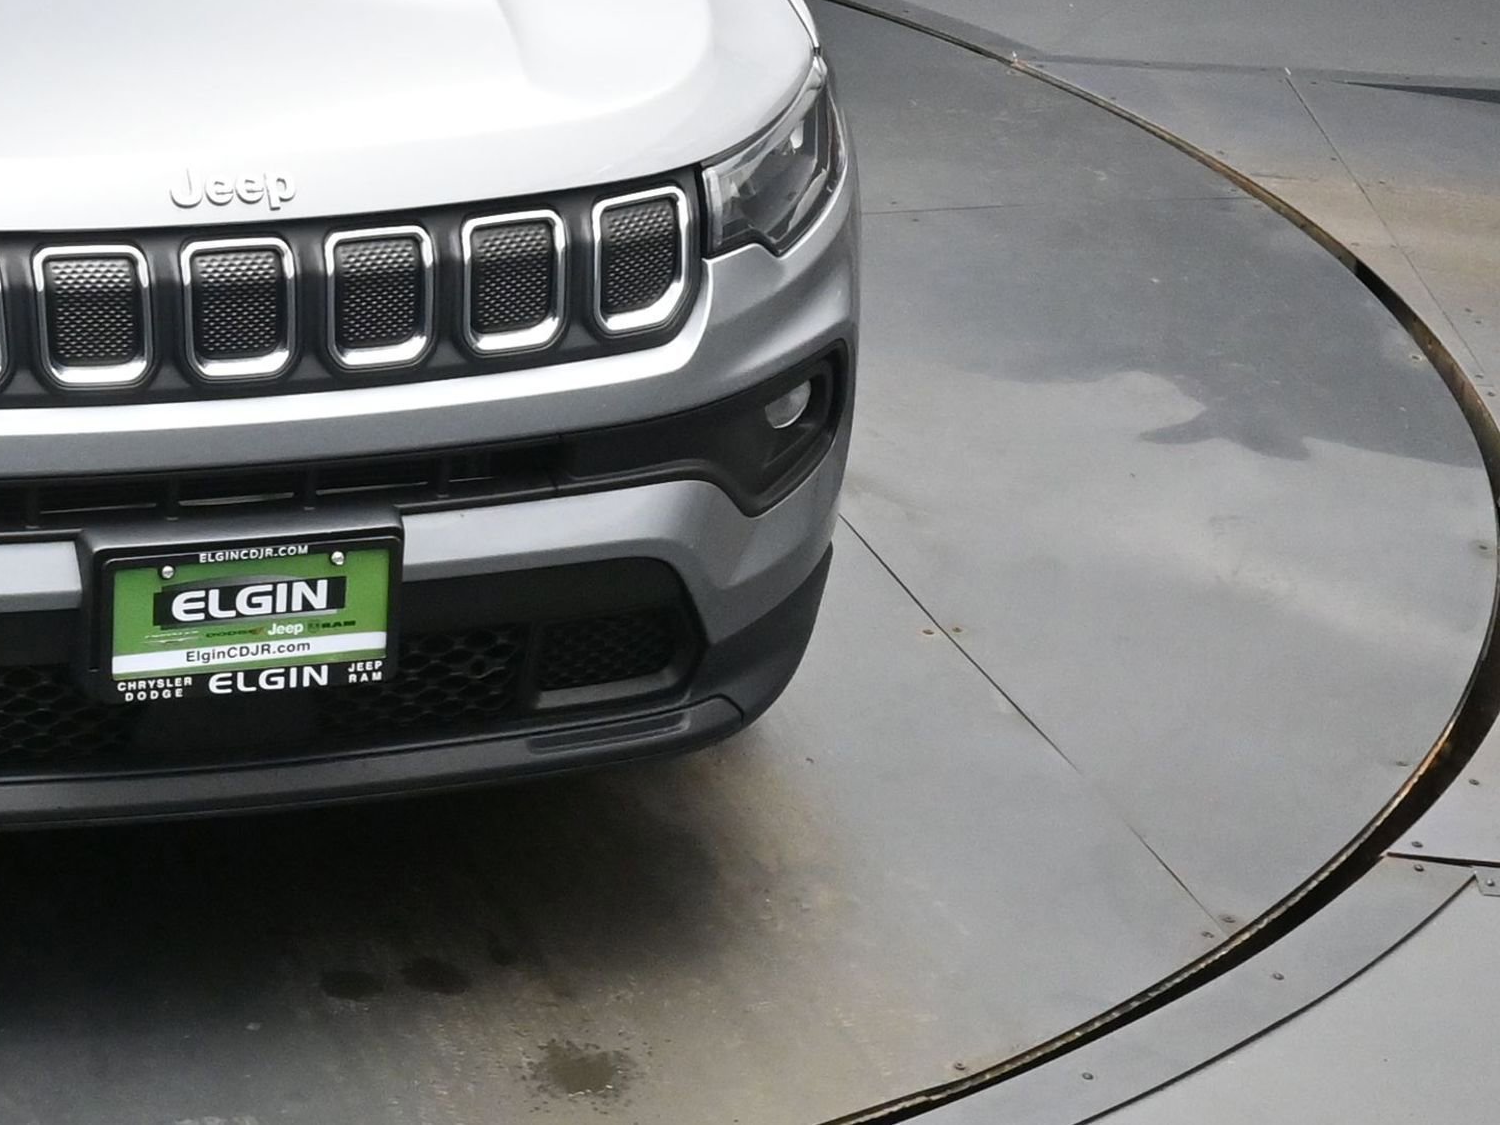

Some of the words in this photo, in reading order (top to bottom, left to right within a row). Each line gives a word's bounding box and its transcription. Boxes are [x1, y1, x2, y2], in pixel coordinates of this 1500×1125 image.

[169, 165, 298, 211] Jeep
[199, 545, 309, 563] ELGINCDJR.COM
[171, 579, 328, 622] ELGIN
[267, 622, 304, 636] Jeep
[186, 641, 311, 664] ElginCDJR.com
[349, 661, 383, 673] JEEP
[117, 676, 193, 692] CHRYSLER
[208, 664, 329, 694] ELGIN
[348, 671, 383, 684] RAM
[125, 688, 184, 702] DODGE
